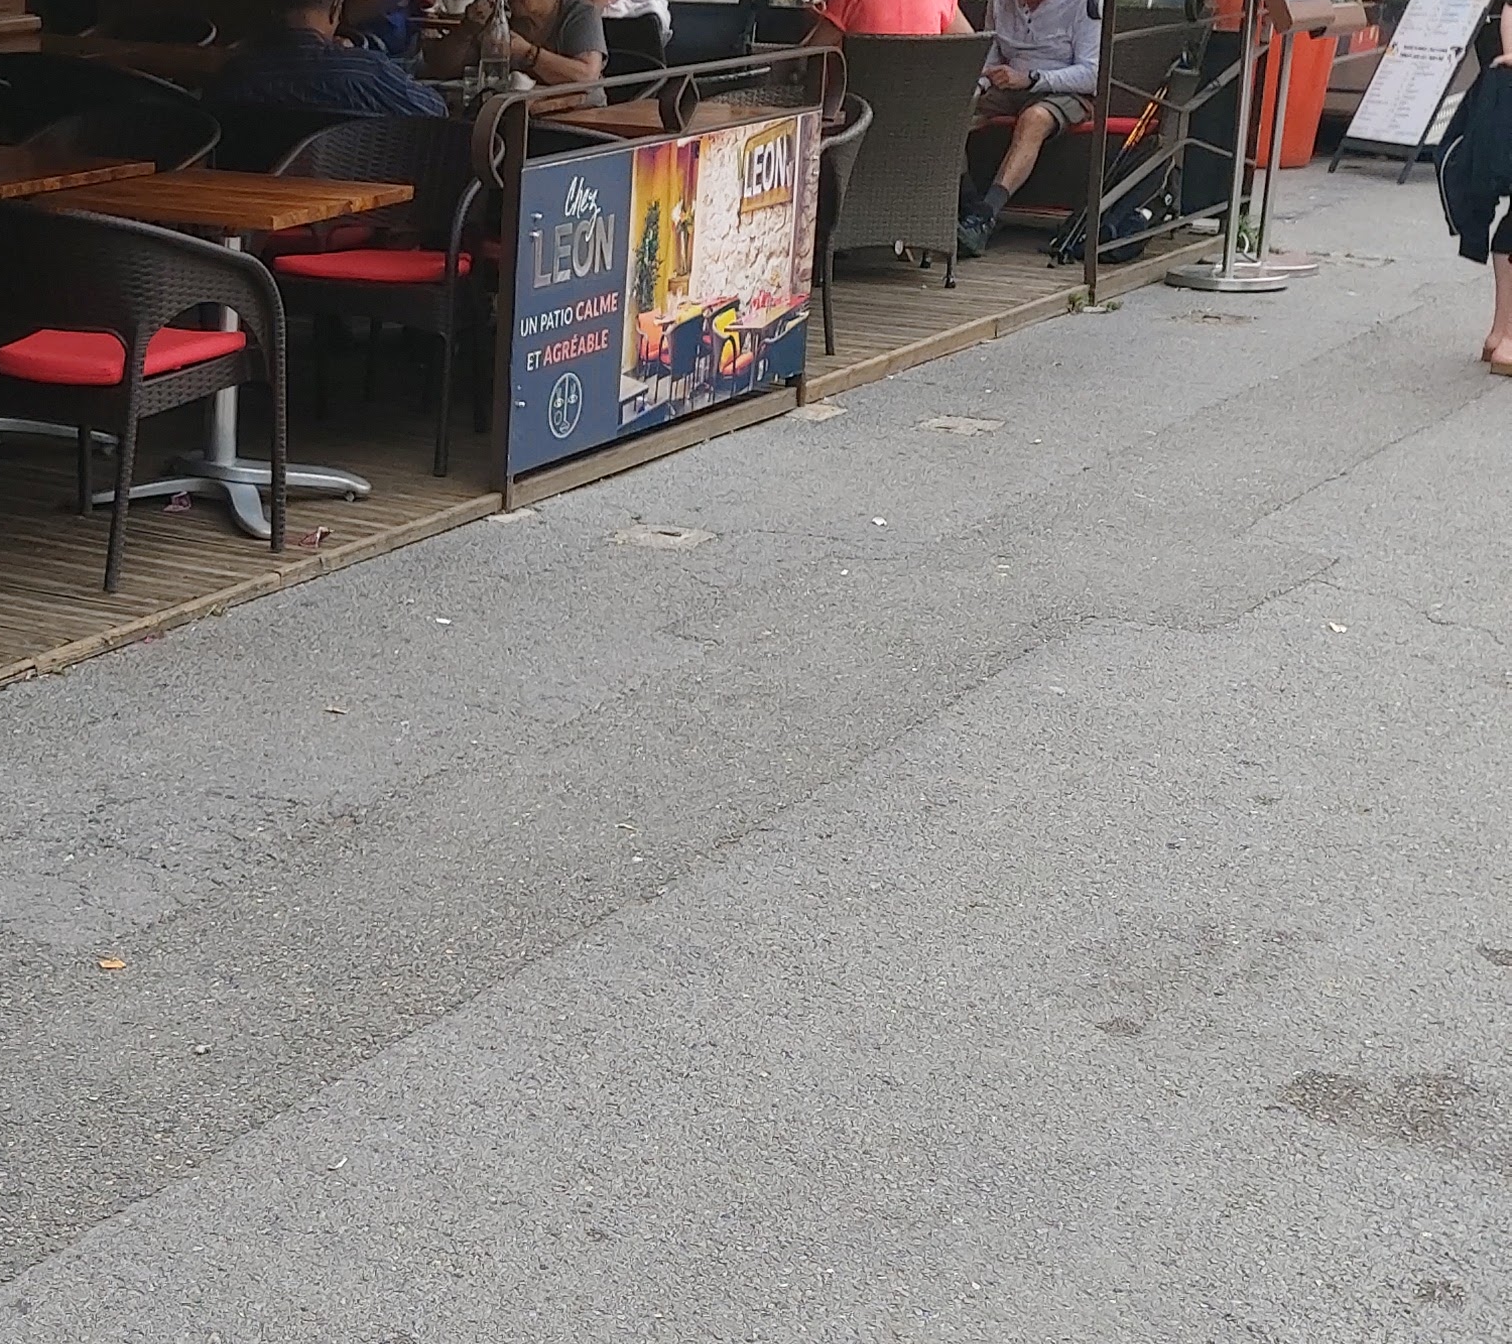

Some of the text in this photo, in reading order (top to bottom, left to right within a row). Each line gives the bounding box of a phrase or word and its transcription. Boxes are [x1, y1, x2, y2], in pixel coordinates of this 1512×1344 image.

[743, 133, 788, 199] LEON
[565, 176, 601, 242] Chez
[533, 213, 615, 289] LEON
[520, 292, 618, 337] UN PATIO CALME
[526, 328, 609, 371] ET AGRÉABLE
